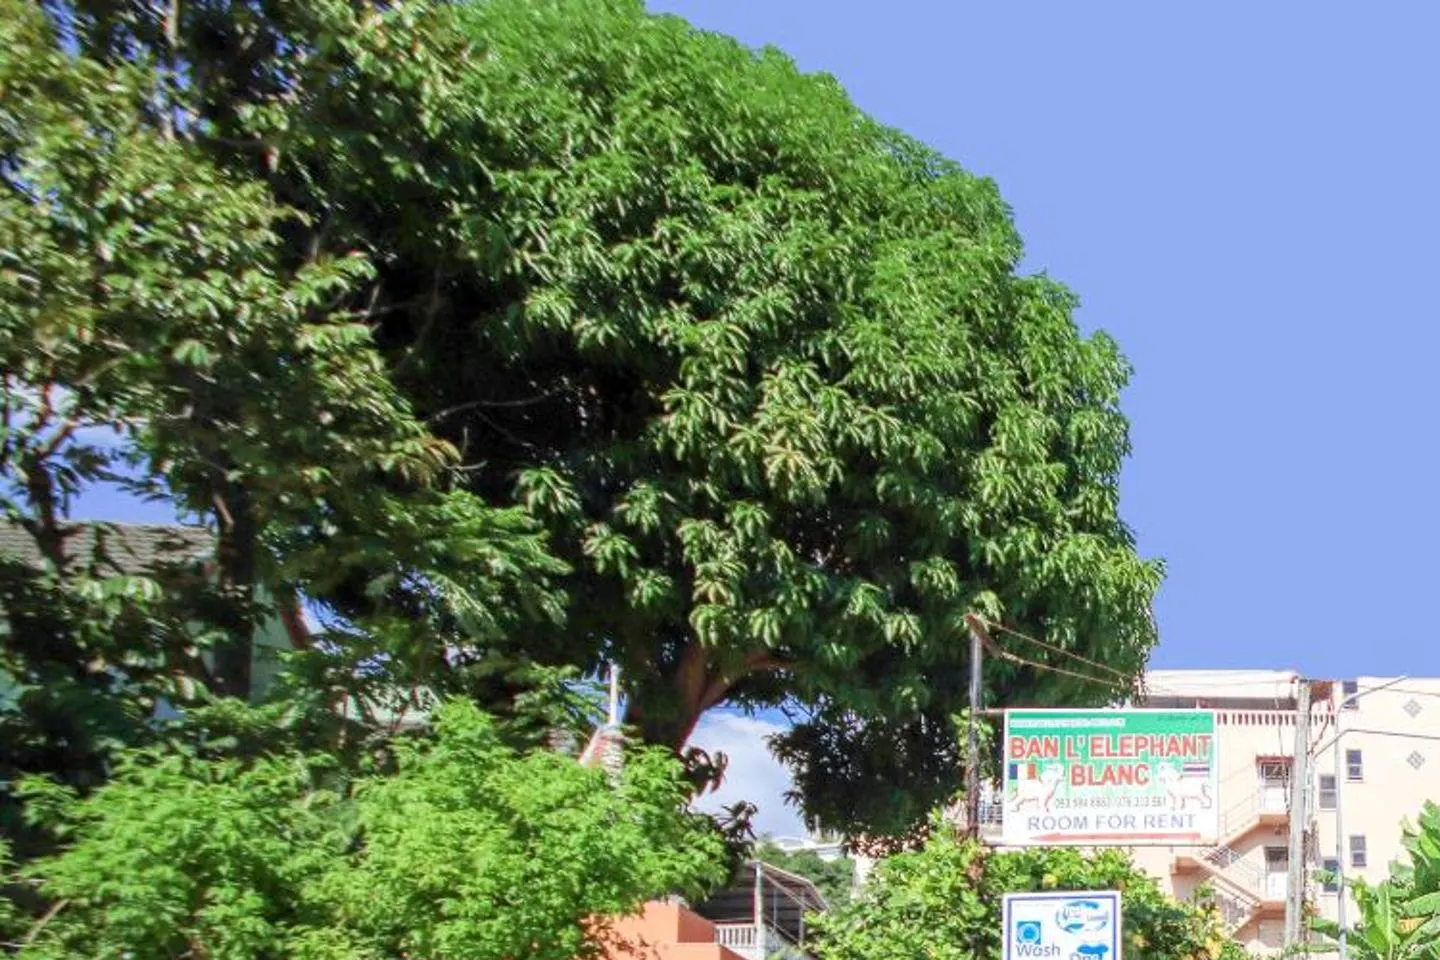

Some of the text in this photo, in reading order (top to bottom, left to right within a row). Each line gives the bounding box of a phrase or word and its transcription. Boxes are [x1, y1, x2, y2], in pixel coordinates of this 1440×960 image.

[1009, 736, 1059, 758] BAN
[1070, 764, 1150, 786] BLANC
[1027, 813, 1196, 831] ROOM FOR RENT
[1016, 943, 1061, 958] Wash
